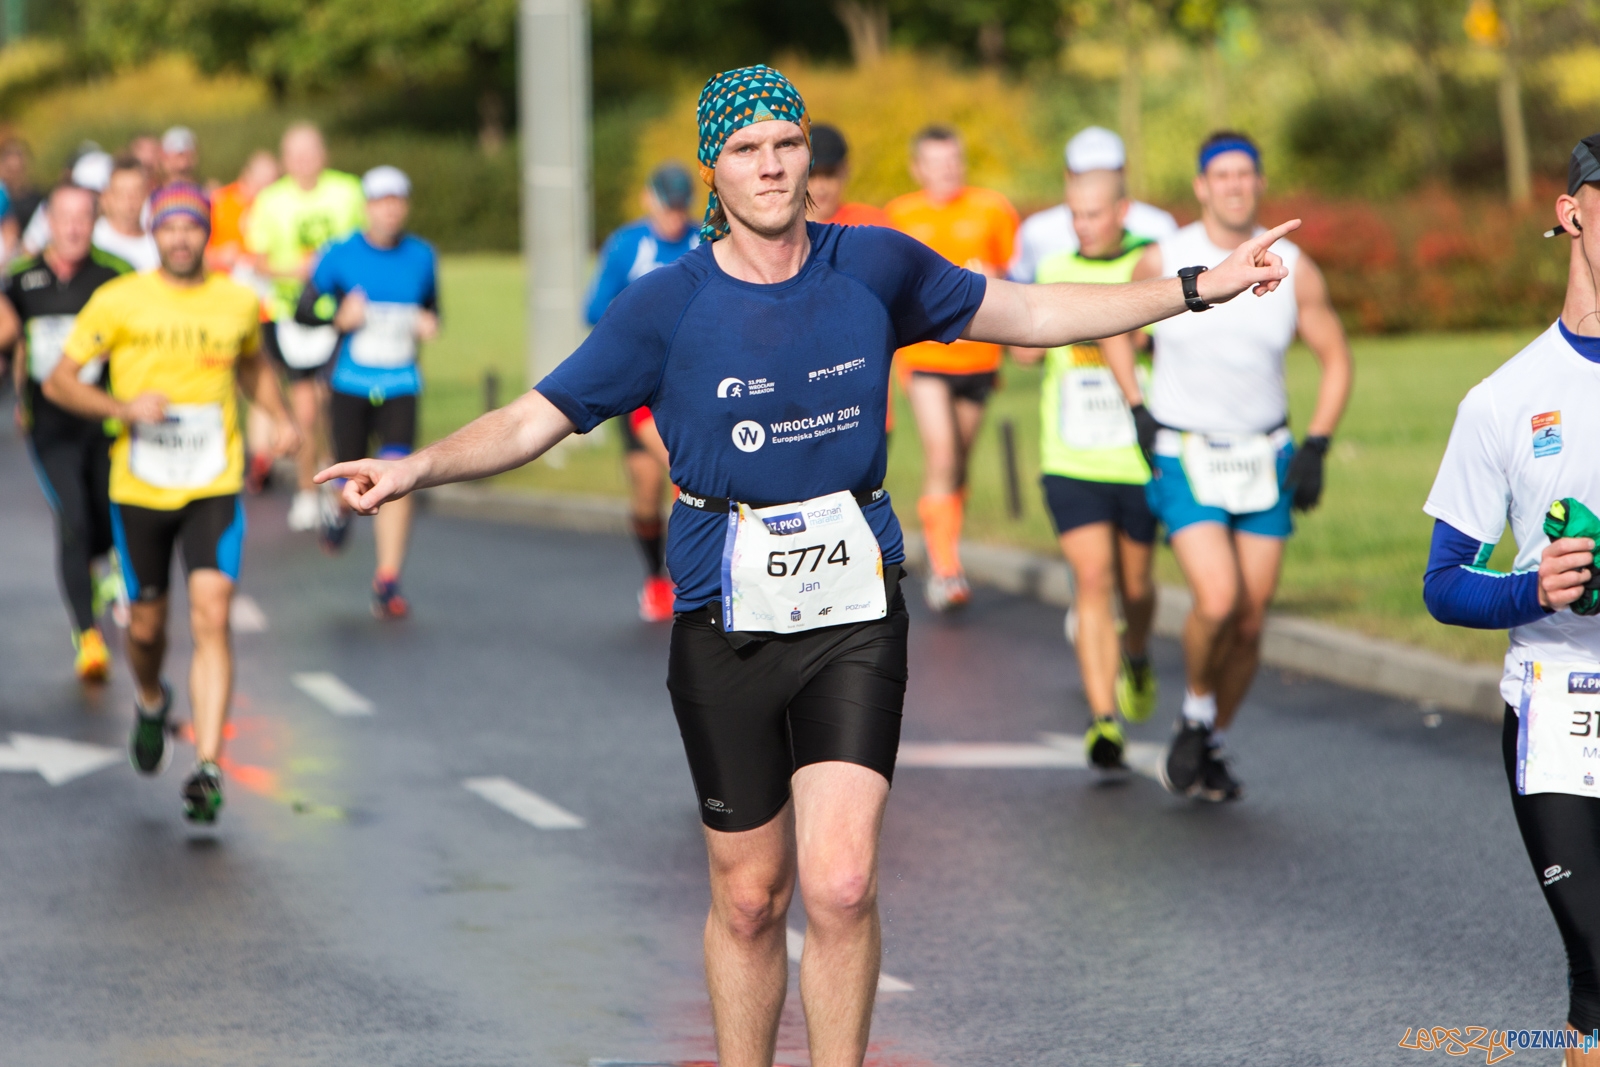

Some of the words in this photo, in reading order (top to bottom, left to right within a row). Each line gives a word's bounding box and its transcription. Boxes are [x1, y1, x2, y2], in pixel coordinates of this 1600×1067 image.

[808, 357, 866, 379] BRUBECK
[748, 387, 775, 396] MARATON
[770, 412, 835, 434] WROCŁAW
[837, 404, 861, 421] 2016
[772, 432, 813, 444] Europejska
[814, 426, 836, 438] Stolica
[836, 420, 860, 431] Kultury
[808, 513, 844, 526] maraton
[767, 539, 851, 577] 6774
[799, 581, 821, 594] Jan
